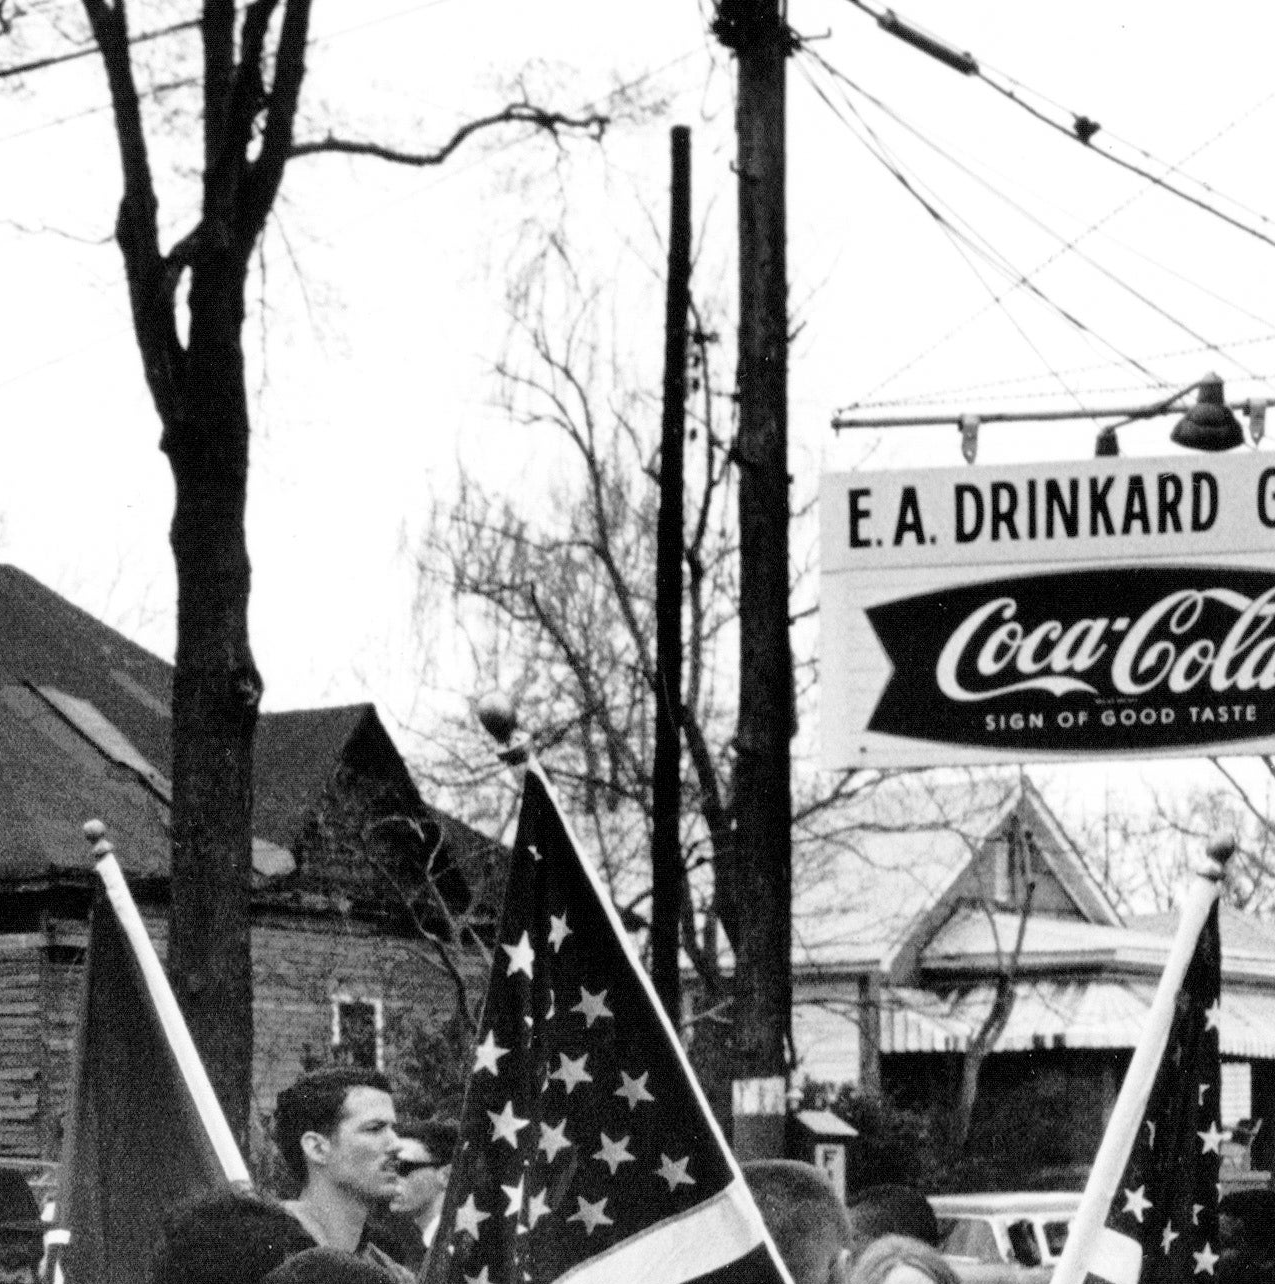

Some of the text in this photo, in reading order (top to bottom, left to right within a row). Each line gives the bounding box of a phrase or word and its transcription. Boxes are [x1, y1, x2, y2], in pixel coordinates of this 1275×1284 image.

[954, 470, 1219, 544] DRINKARD
[935, 587, 1275, 702] Coca-Cola
[985, 705, 1256, 731] SIGN OF GOOD TASTE
